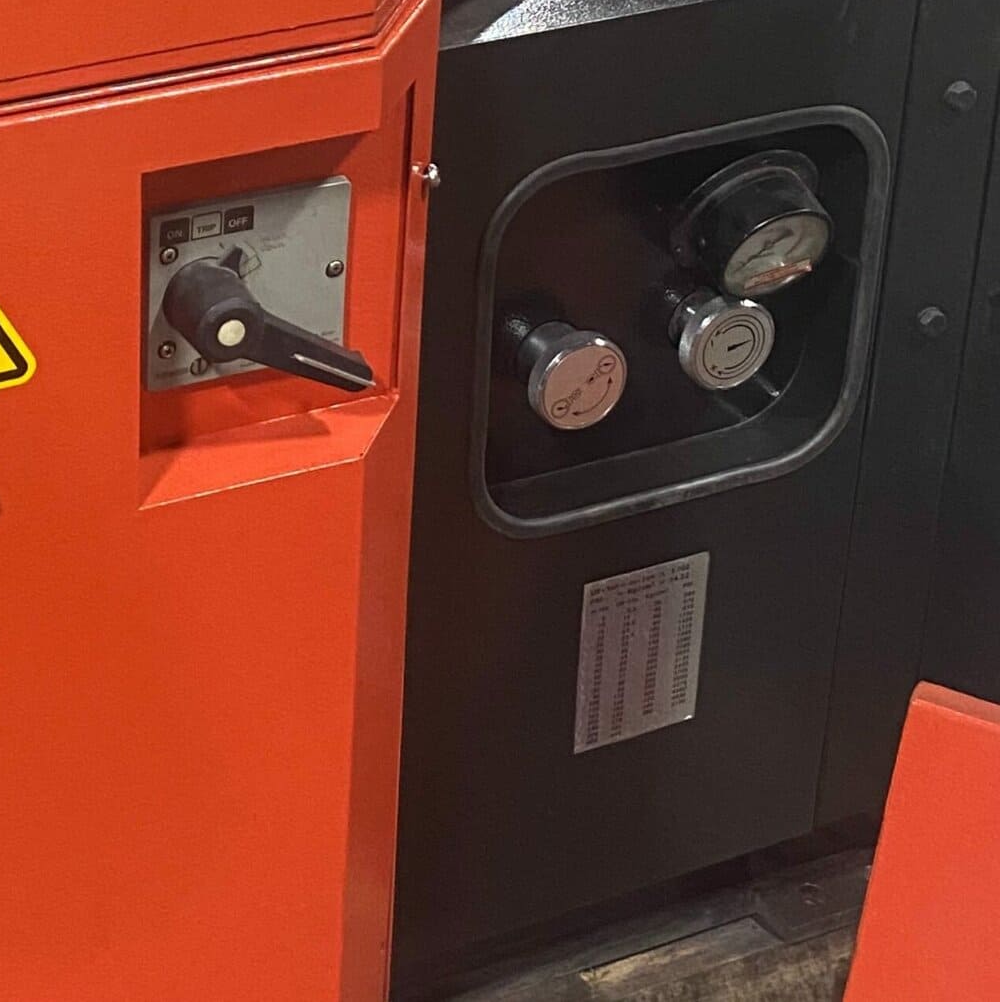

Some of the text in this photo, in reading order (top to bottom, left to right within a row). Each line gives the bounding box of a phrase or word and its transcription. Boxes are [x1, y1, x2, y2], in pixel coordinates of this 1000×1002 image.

[228, 216, 249, 228] OFF
[196, 223, 217, 234] TRIP
[166, 230, 183, 240] ON
